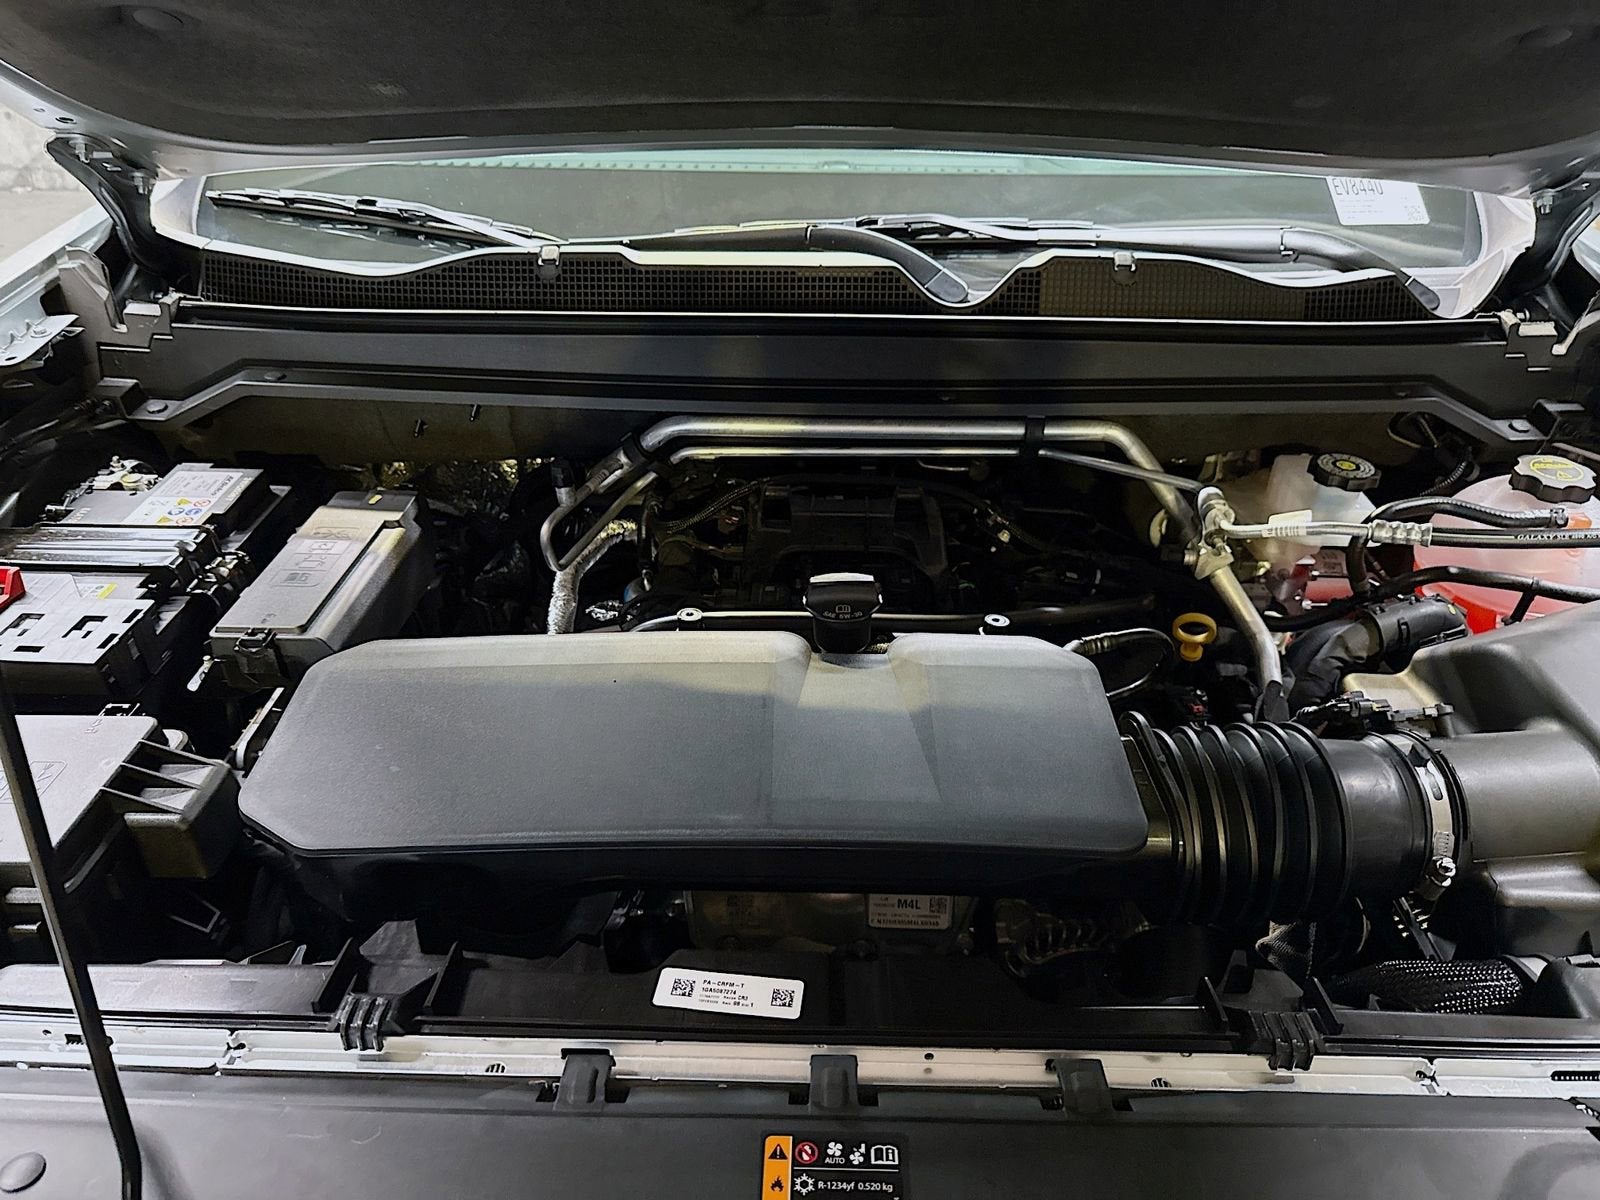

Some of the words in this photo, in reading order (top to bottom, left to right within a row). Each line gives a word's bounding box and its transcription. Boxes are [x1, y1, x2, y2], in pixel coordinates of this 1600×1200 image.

[897, 898, 921, 910] M4L
[824, 1157, 846, 1165] AUTO
[817, 1181, 856, 1192] R-1234yf
[857, 1182, 881, 1191] 0.520
[882, 1182, 893, 1193] kg
